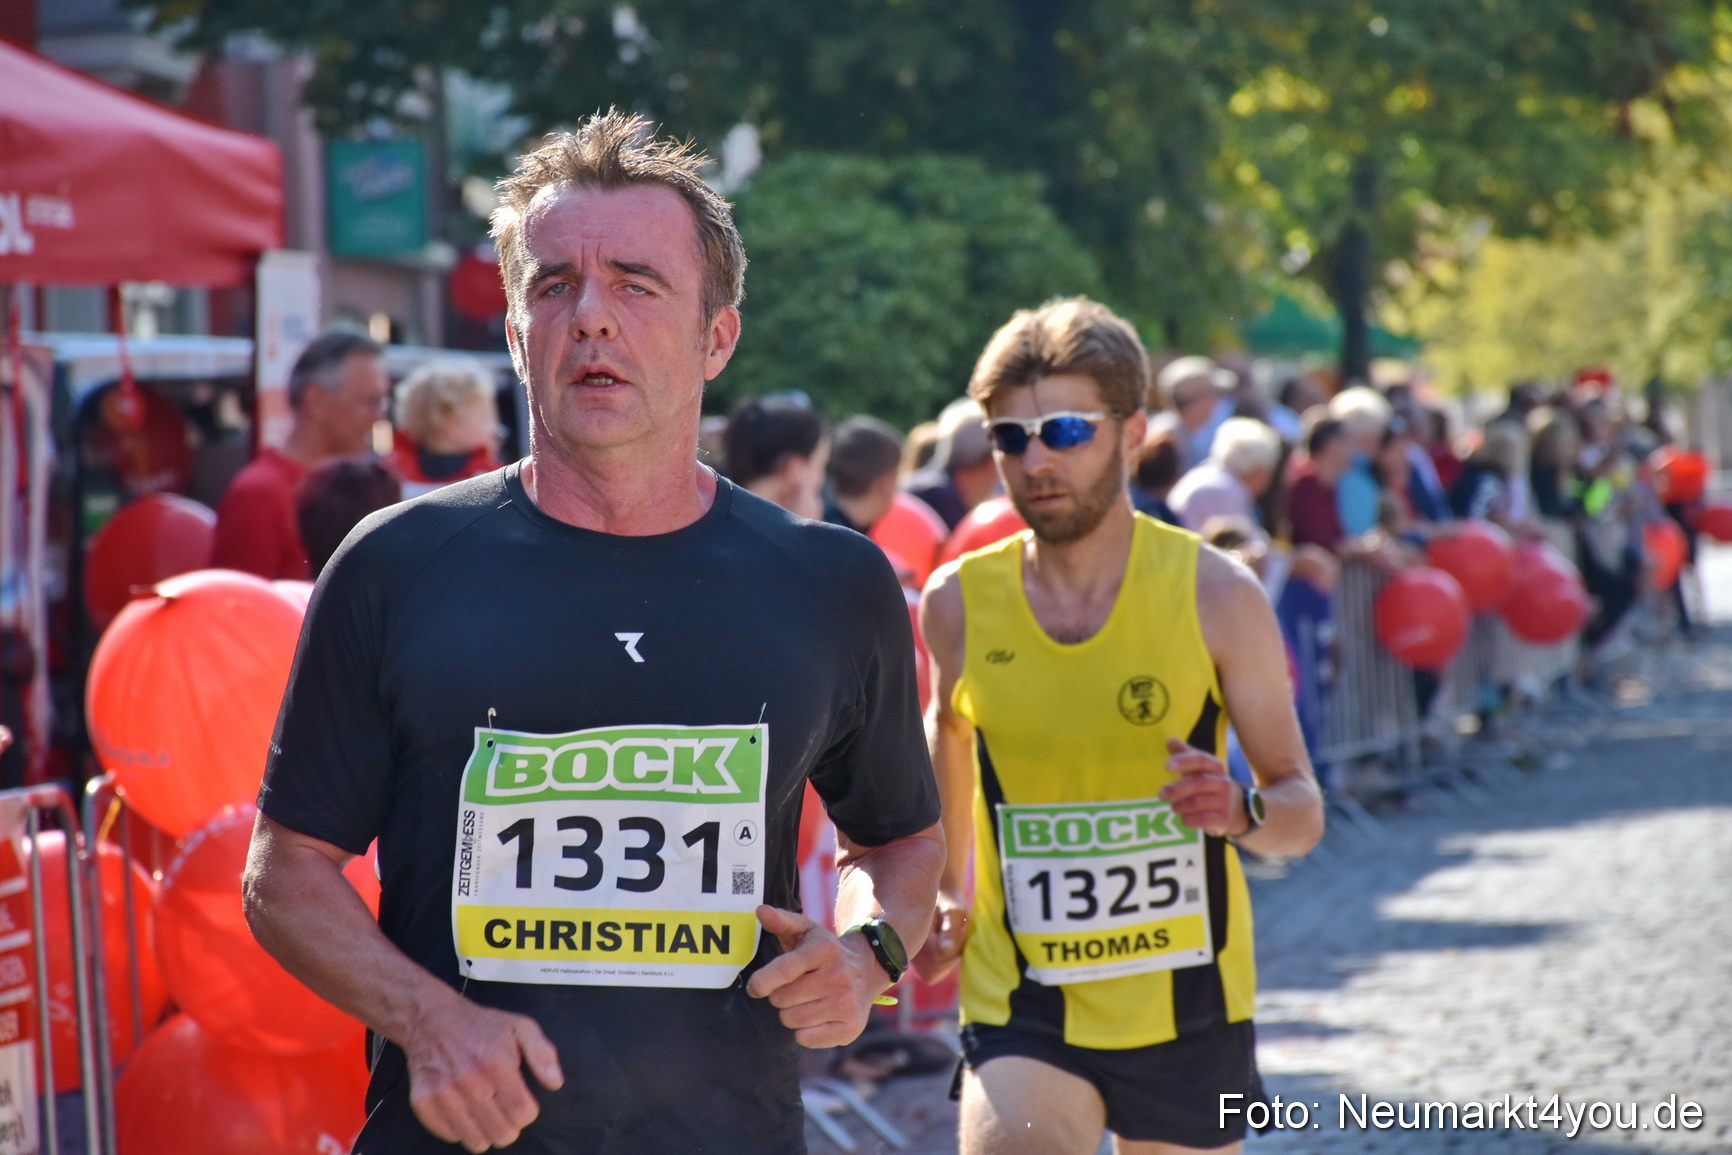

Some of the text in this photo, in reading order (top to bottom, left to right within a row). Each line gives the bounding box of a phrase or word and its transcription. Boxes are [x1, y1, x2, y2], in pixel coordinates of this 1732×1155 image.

[488, 740, 736, 793] BOCK
[738, 826, 752, 840] A
[1014, 810, 1178, 850] BOCK
[496, 815, 720, 894] 1331
[1028, 858, 1180, 922] 1325
[483, 918, 731, 955] CHRISTIAN
[1041, 928, 1170, 962] THOMAS
